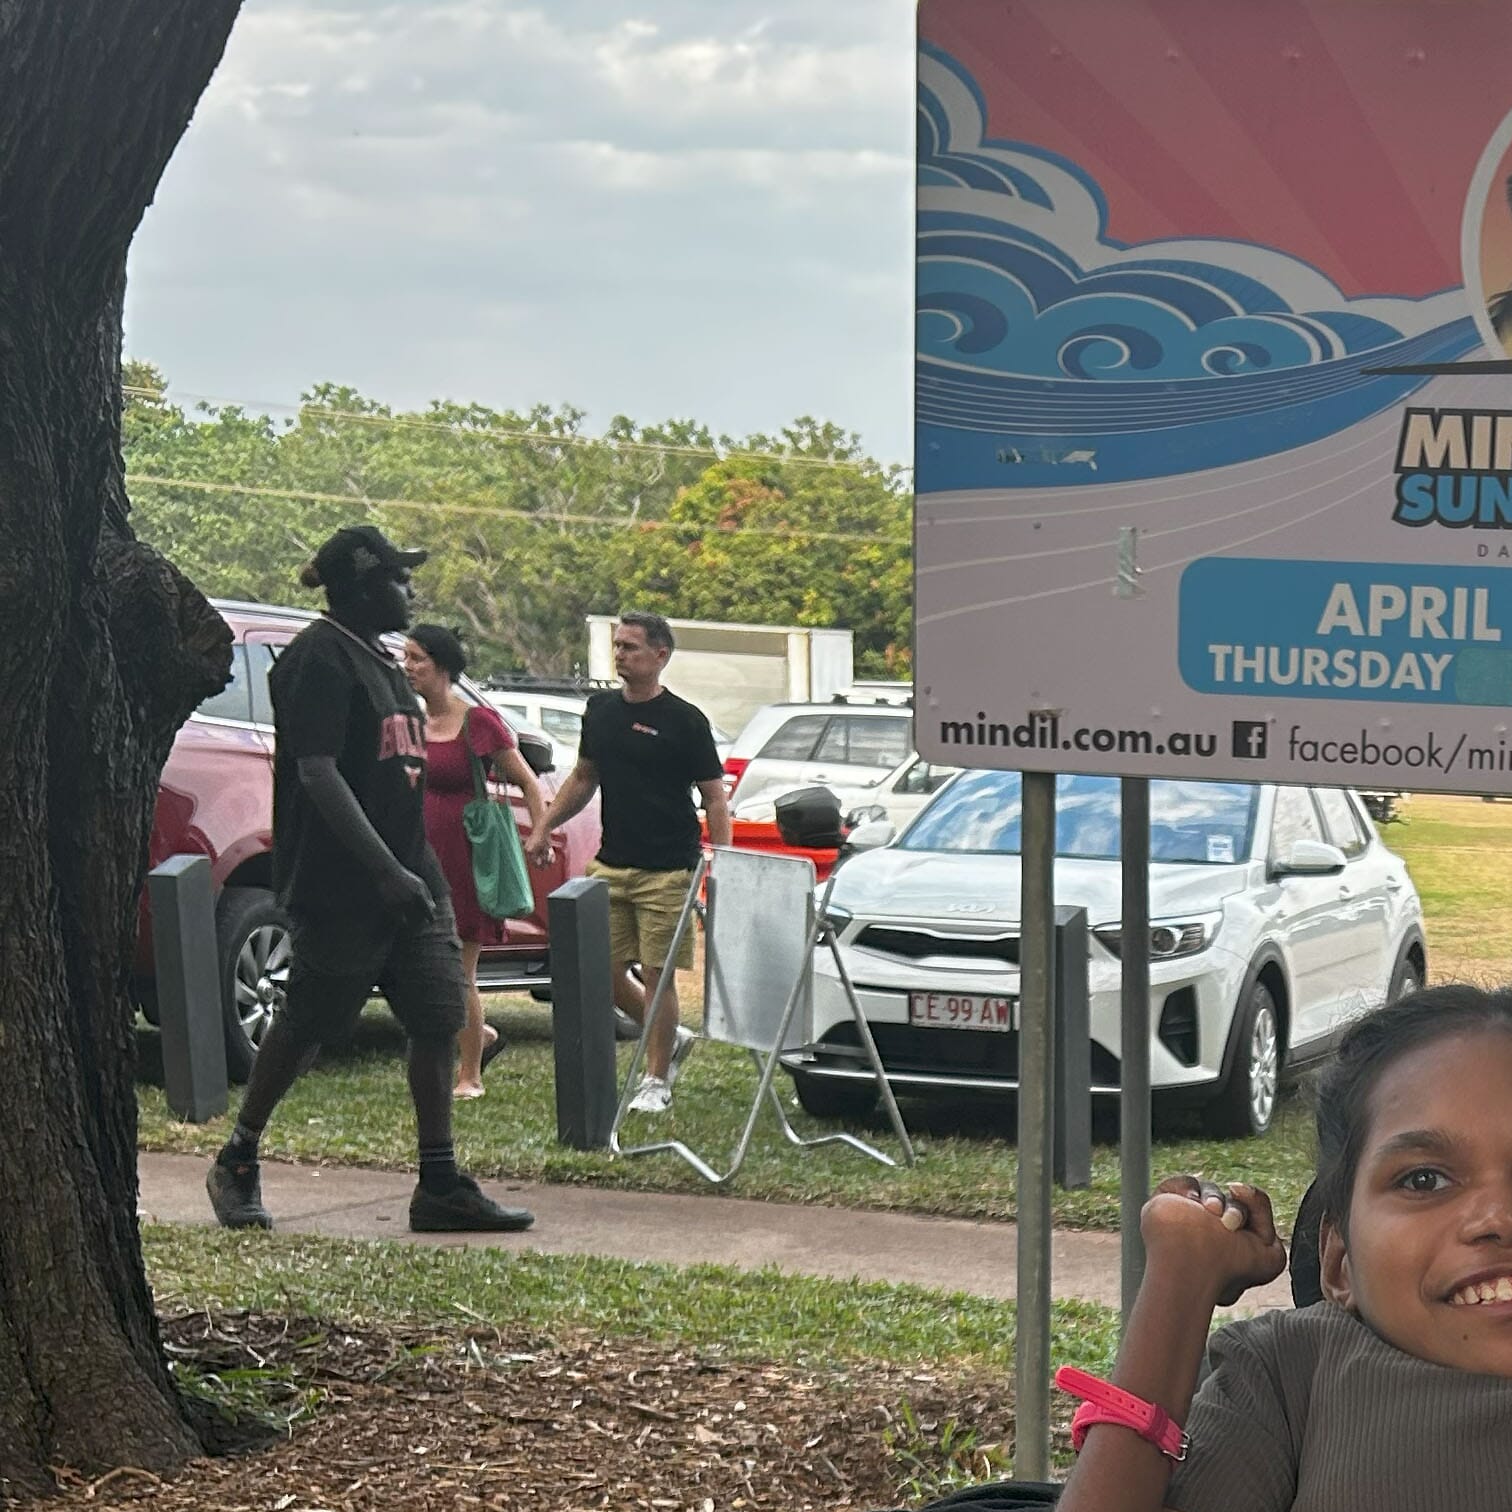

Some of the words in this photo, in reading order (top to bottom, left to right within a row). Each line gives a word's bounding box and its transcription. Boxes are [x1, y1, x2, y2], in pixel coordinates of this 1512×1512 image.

[1316, 582, 1501, 642] APRIL
[1208, 643, 1454, 691] THURSDAY
[941, 711, 1218, 758] mindil.com.au
